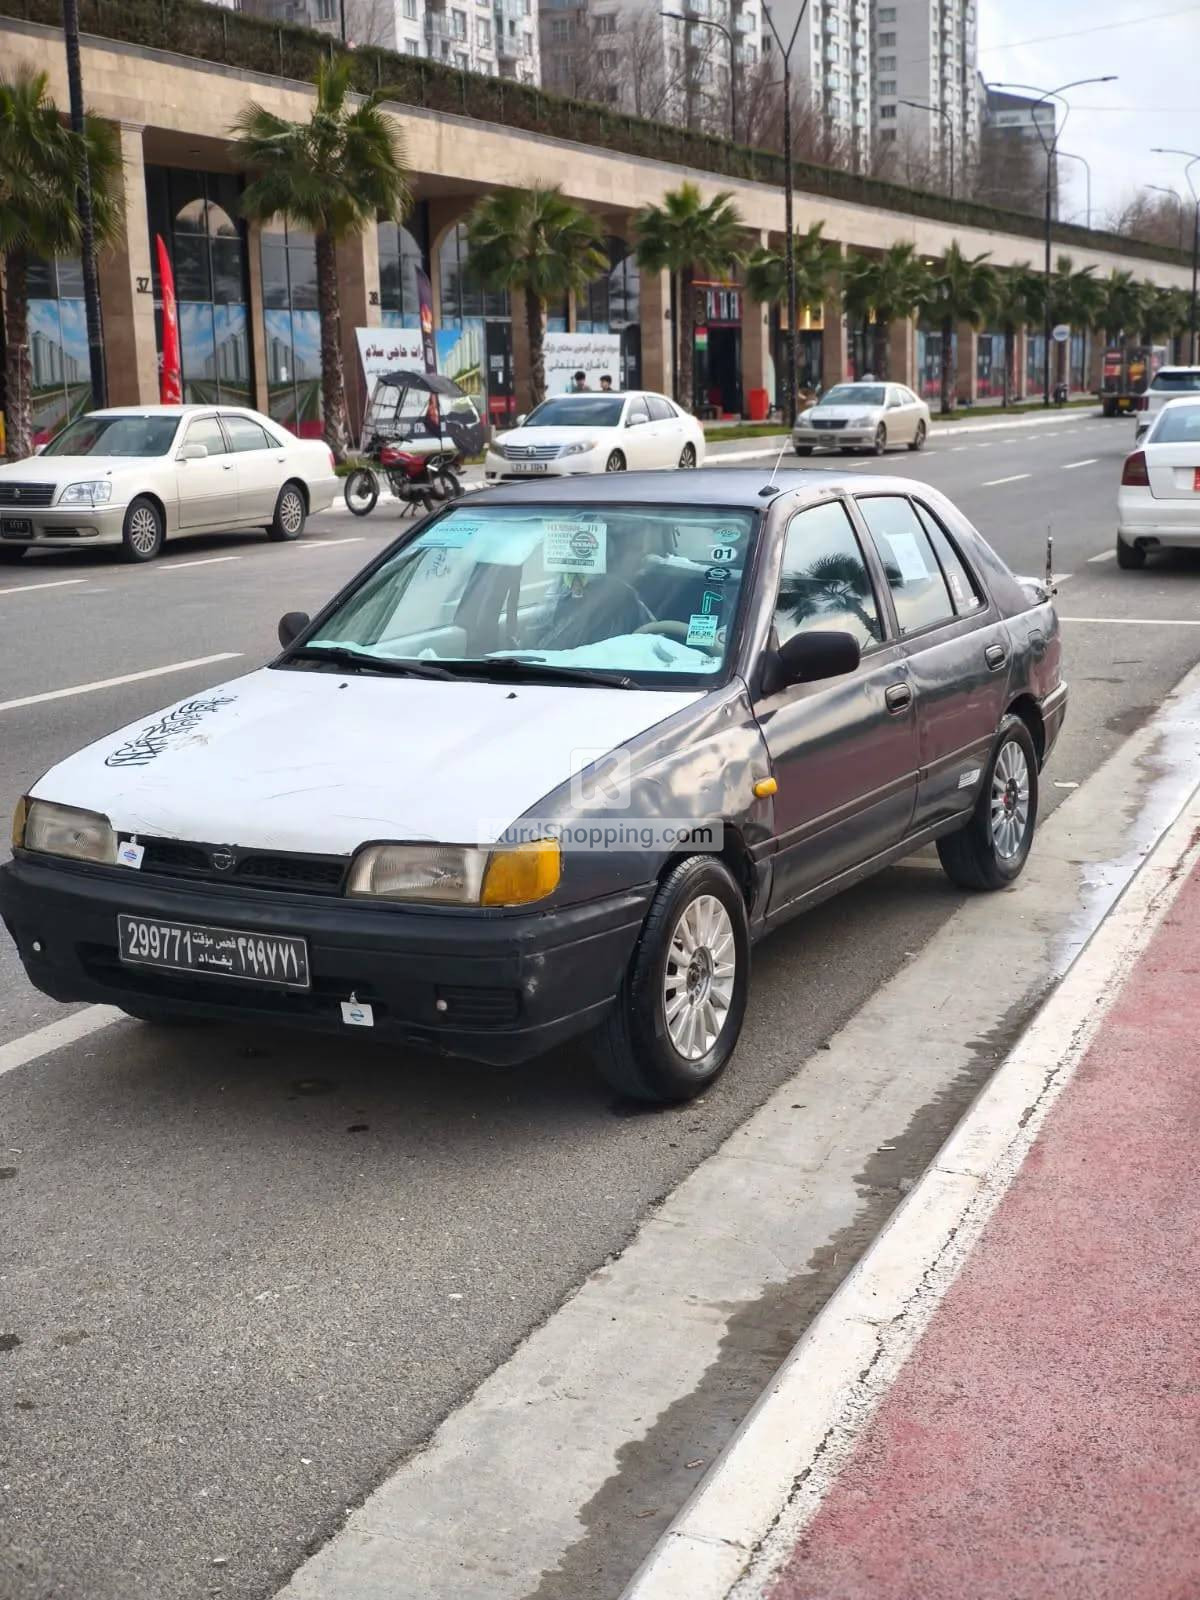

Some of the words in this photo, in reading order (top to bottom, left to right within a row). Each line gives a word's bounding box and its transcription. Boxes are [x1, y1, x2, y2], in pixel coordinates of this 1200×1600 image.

[136, 276, 150, 293] 37
[713, 548, 732, 559] 01
[128, 922, 192, 963] 299771
[192, 931, 214, 946] مؤقت
[198, 954, 232, 970] بغداد
[237, 937, 298, 978] ٢٩٩٧٧١
